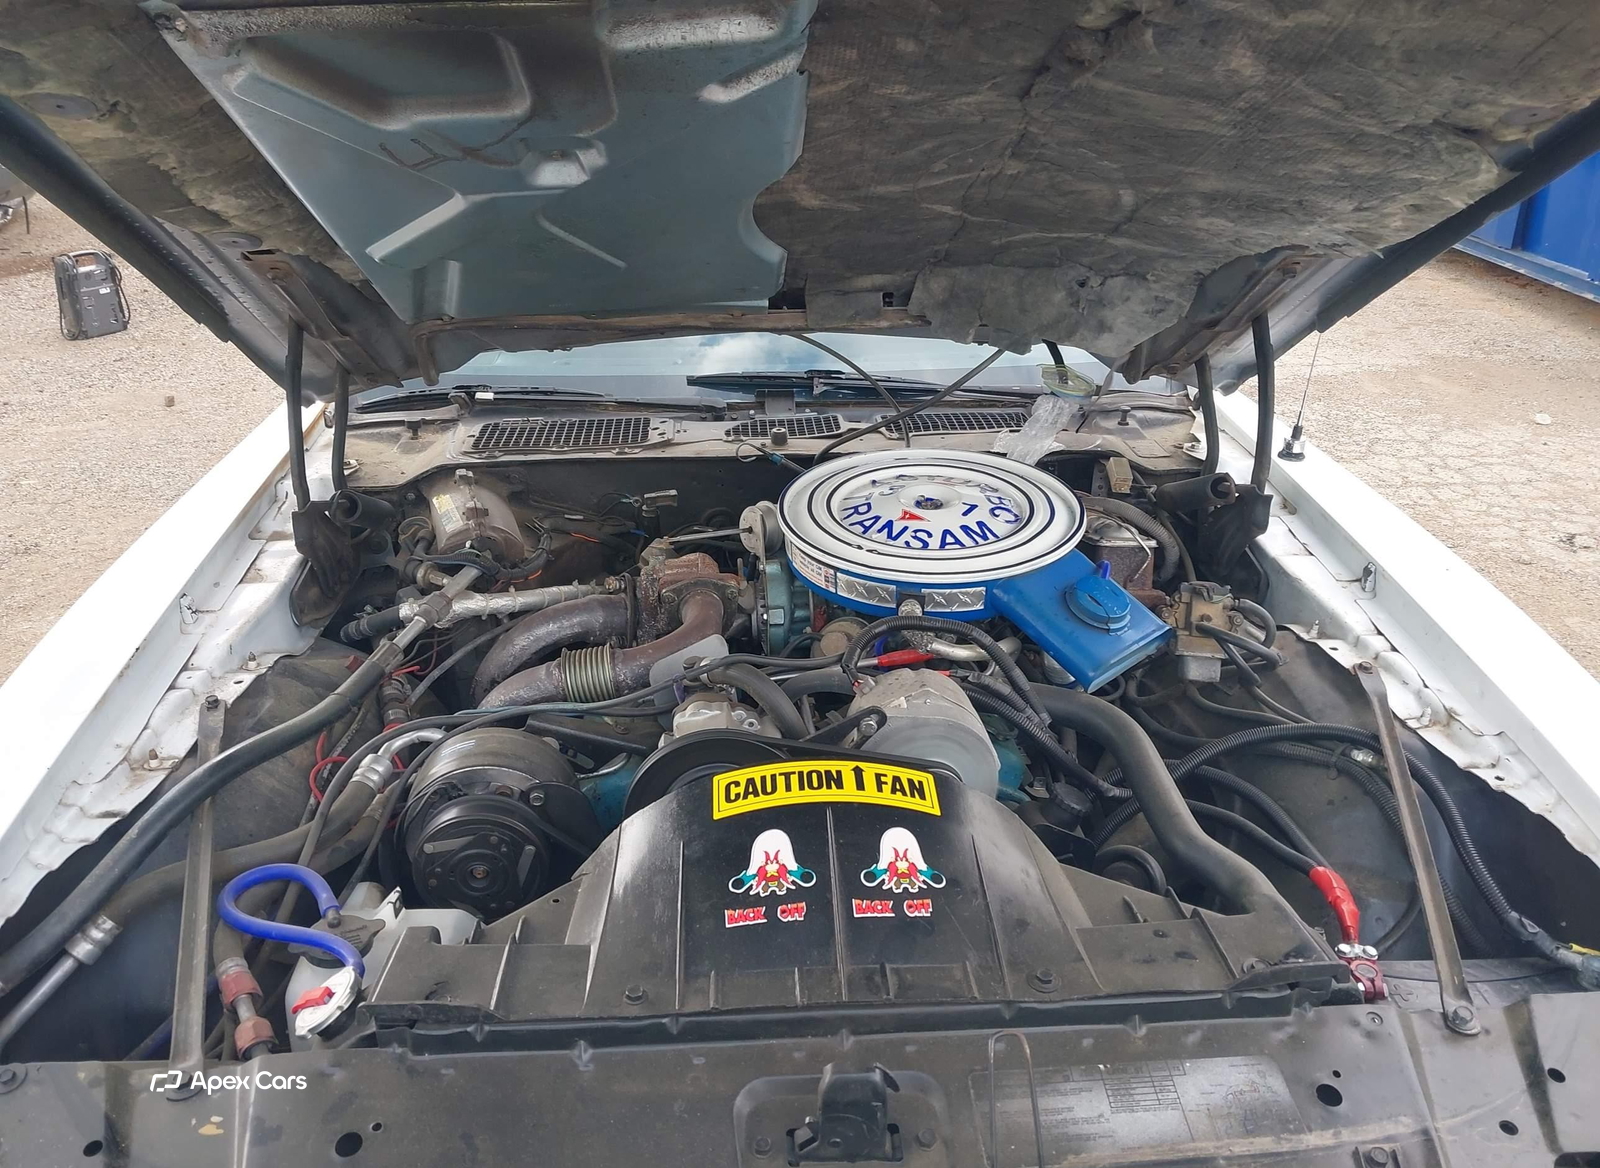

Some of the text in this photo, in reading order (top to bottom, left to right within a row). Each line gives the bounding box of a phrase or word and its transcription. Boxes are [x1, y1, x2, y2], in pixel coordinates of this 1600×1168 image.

[724, 769, 926, 803] CAUTION FAN
[725, 902, 806, 928] BACK OFF
[852, 899, 932, 917] BACK OFF
